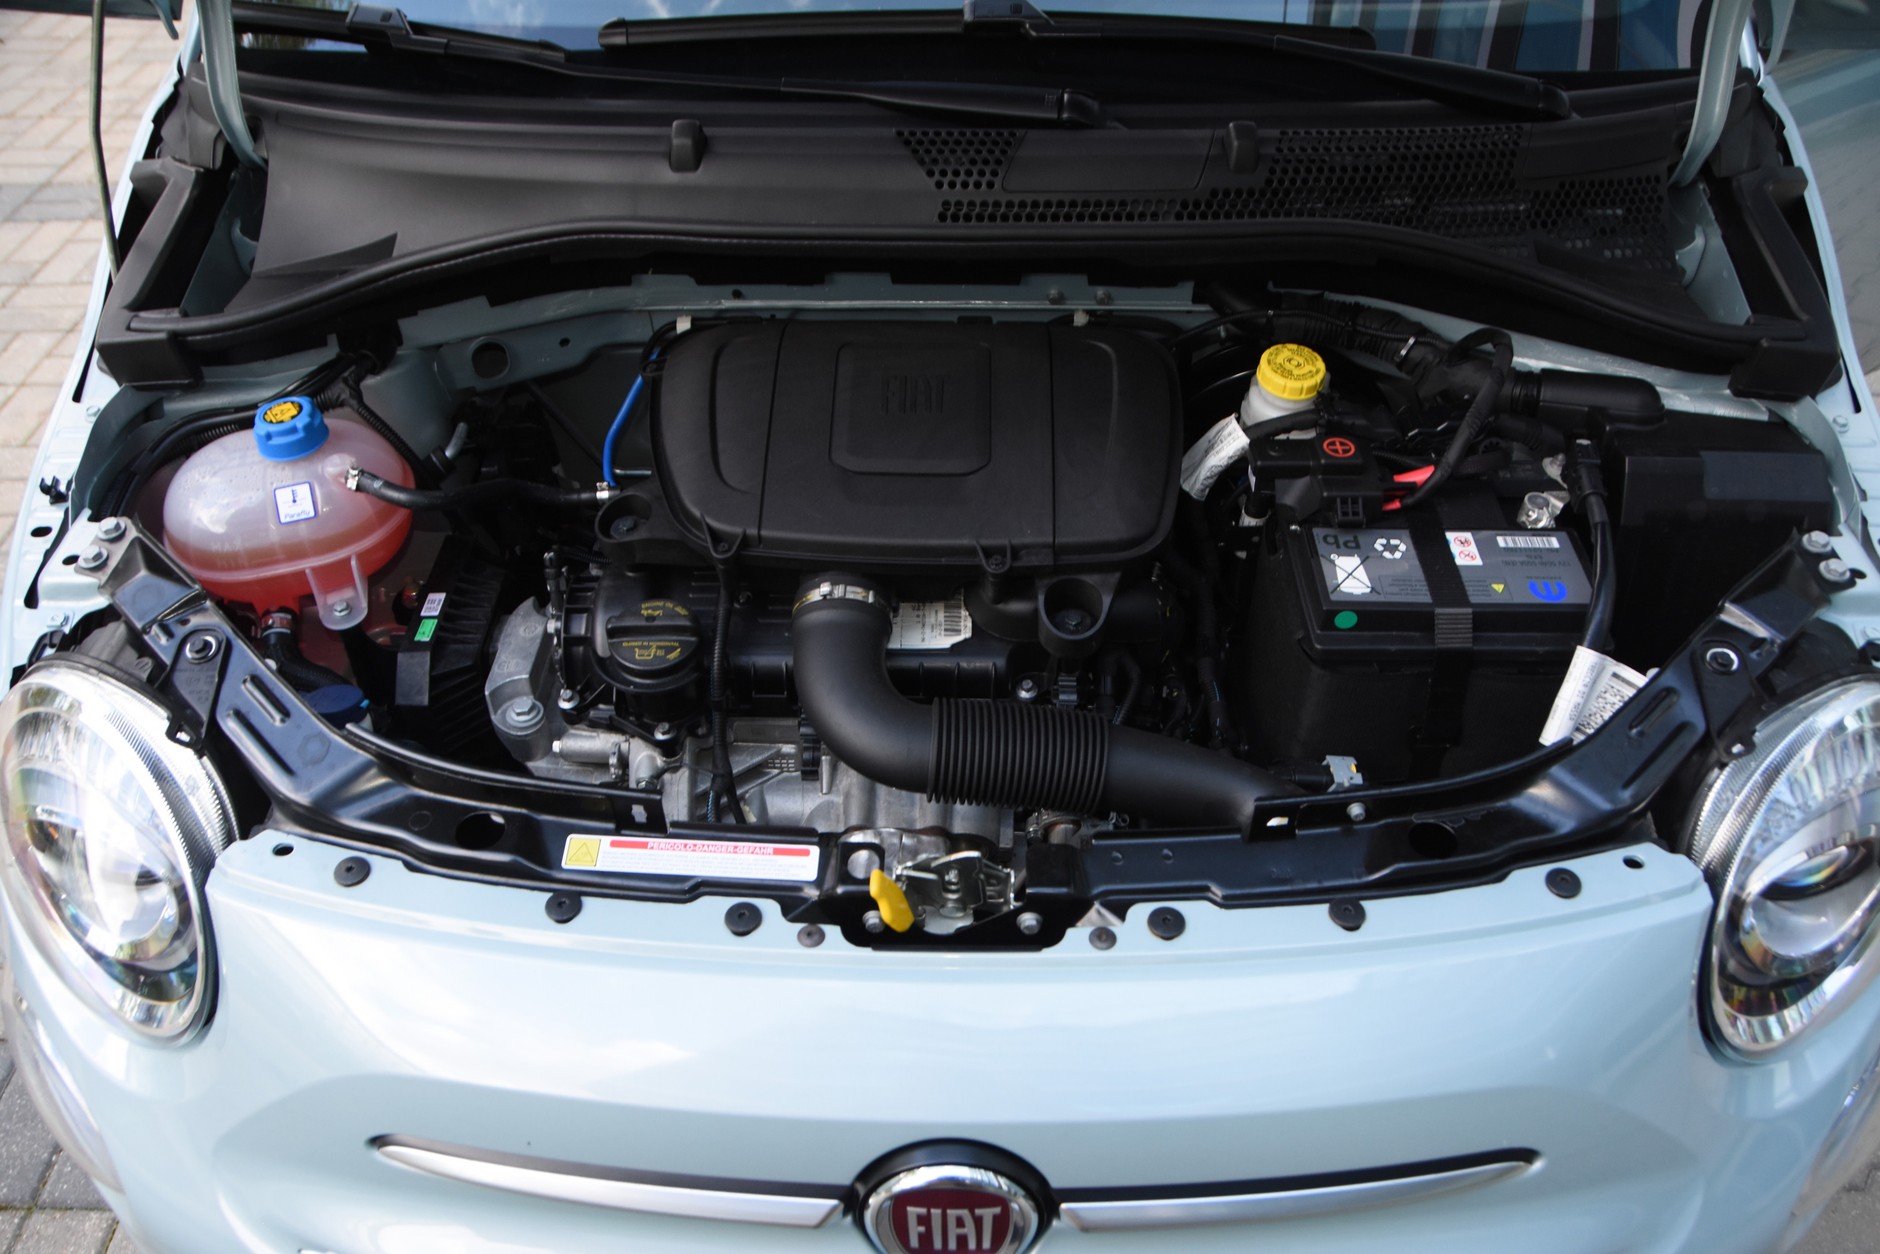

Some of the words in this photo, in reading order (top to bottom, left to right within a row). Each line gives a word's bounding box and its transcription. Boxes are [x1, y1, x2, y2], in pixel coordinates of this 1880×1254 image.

[880, 374, 951, 415] FIAT
[1321, 533, 1362, 550] Pb
[647, 841, 774, 855] PERICOLO-DANGER-GEFAHR
[906, 1205, 1002, 1250] FIAT
